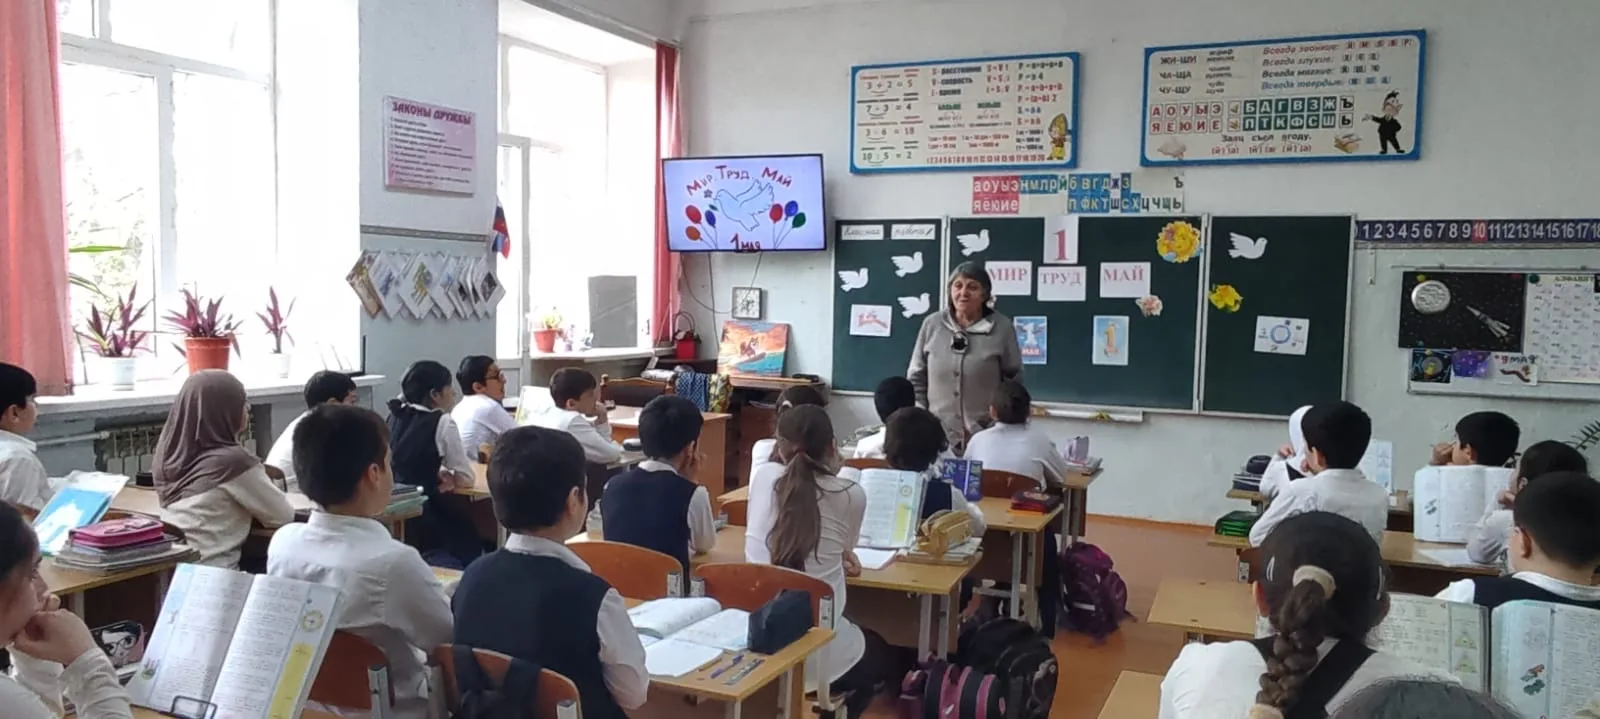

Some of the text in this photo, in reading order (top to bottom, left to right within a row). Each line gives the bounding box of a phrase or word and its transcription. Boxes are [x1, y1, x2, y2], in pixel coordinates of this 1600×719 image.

[1263, 47, 1296, 55] Всегда
[1160, 56, 1196, 64] ЖИ-ШИ
[1160, 71, 1192, 79] ЧА-ЩА
[1262, 70, 1295, 78] Всегда
[907, 79, 912, 87] 5
[1159, 86, 1191, 94] ЧУ-ЩУ
[392, 101, 471, 125] ЗАКОНЫ ДРУЖБЫ
[1167, 106, 1176, 115] О
[1181, 106, 1190, 116] У
[1196, 104, 1207, 115] Ы
[1212, 103, 1221, 114] Э
[1246, 102, 1256, 112] Б
[1277, 101, 1284, 111] Г
[1294, 100, 1303, 110] В
[1309, 99, 1318, 109] З
[1323, 97, 1335, 109] Ж
[1342, 98, 1353, 109] Ъ
[1152, 123, 1160, 133] Я
[1196, 121, 1205, 130] И
[1212, 120, 1219, 130] Е
[1245, 119, 1255, 129] П
[1261, 118, 1271, 129] Т
[1277, 117, 1286, 128] К
[1291, 117, 1303, 127] Ф
[1308, 116, 1318, 126] С
[1323, 115, 1335, 125] Ш
[1341, 115, 1351, 125] Ь
[1363, 224, 1369, 238] 1
[1374, 224, 1383, 238] 2
[1386, 224, 1395, 238] 3
[1398, 224, 1407, 238] 4
[1411, 224, 1419, 238] 5
[1423, 224, 1432, 238] 6
[1436, 224, 1445, 238] 7
[1449, 224, 1458, 238] 8
[1462, 224, 1470, 238] 9
[1473, 224, 1486, 238] 10
[1488, 224, 1501, 238] 11
[1502, 224, 1515, 238] 12
[1517, 224, 1529, 238] 13
[1532, 224, 1544, 238] 14
[1546, 224, 1560, 238] 15
[1562, 224, 1574, 238] 16
[1576, 224, 1590, 238] 17
[730, 233, 739, 249] 1
[1052, 229, 1068, 260] 1
[989, 268, 1028, 281] МИР
[1040, 272, 1081, 286] ТРУД
[1103, 265, 1145, 282] МАЙ
